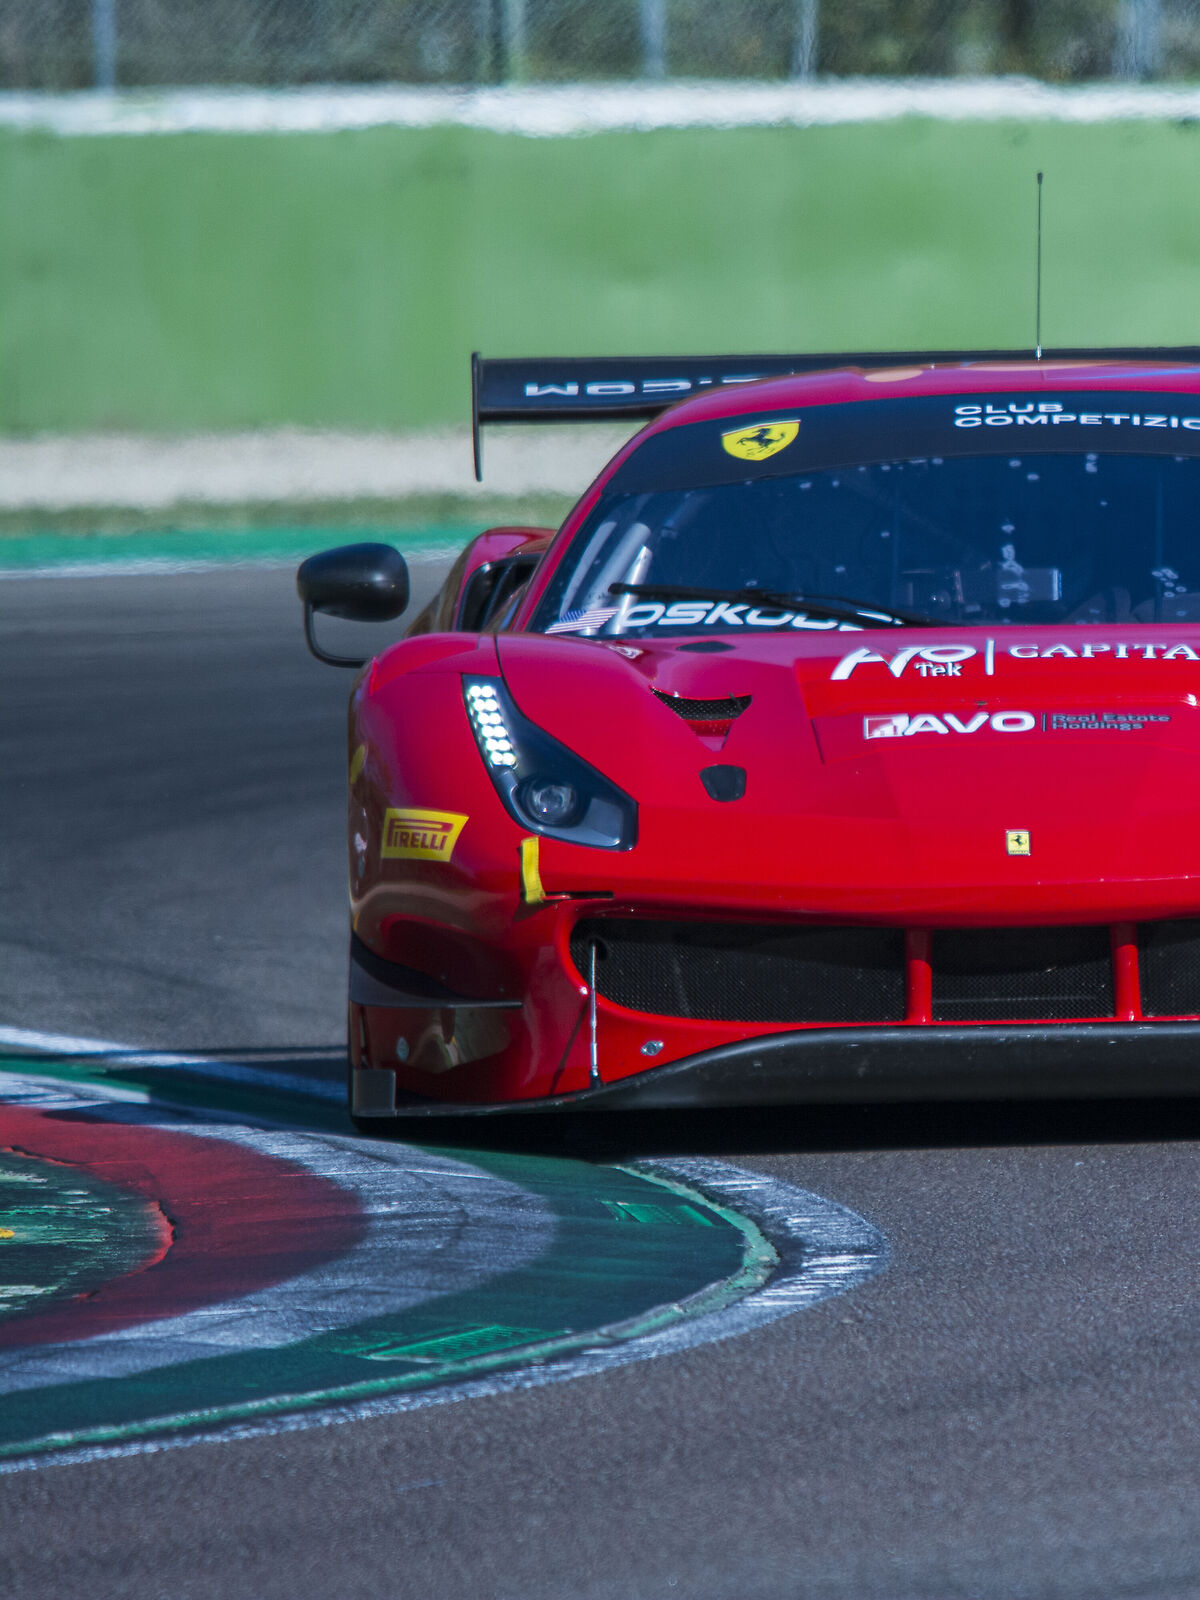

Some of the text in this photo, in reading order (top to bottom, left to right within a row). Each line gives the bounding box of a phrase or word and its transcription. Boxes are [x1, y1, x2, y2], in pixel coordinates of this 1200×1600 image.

[954, 402, 1064, 415] CLUB
[915, 662, 964, 677] Tek
[902, 711, 1171, 736] AVO Real Estate
[1051, 721, 1144, 731] Holdings
[386, 818, 454, 851] PIRELLI
